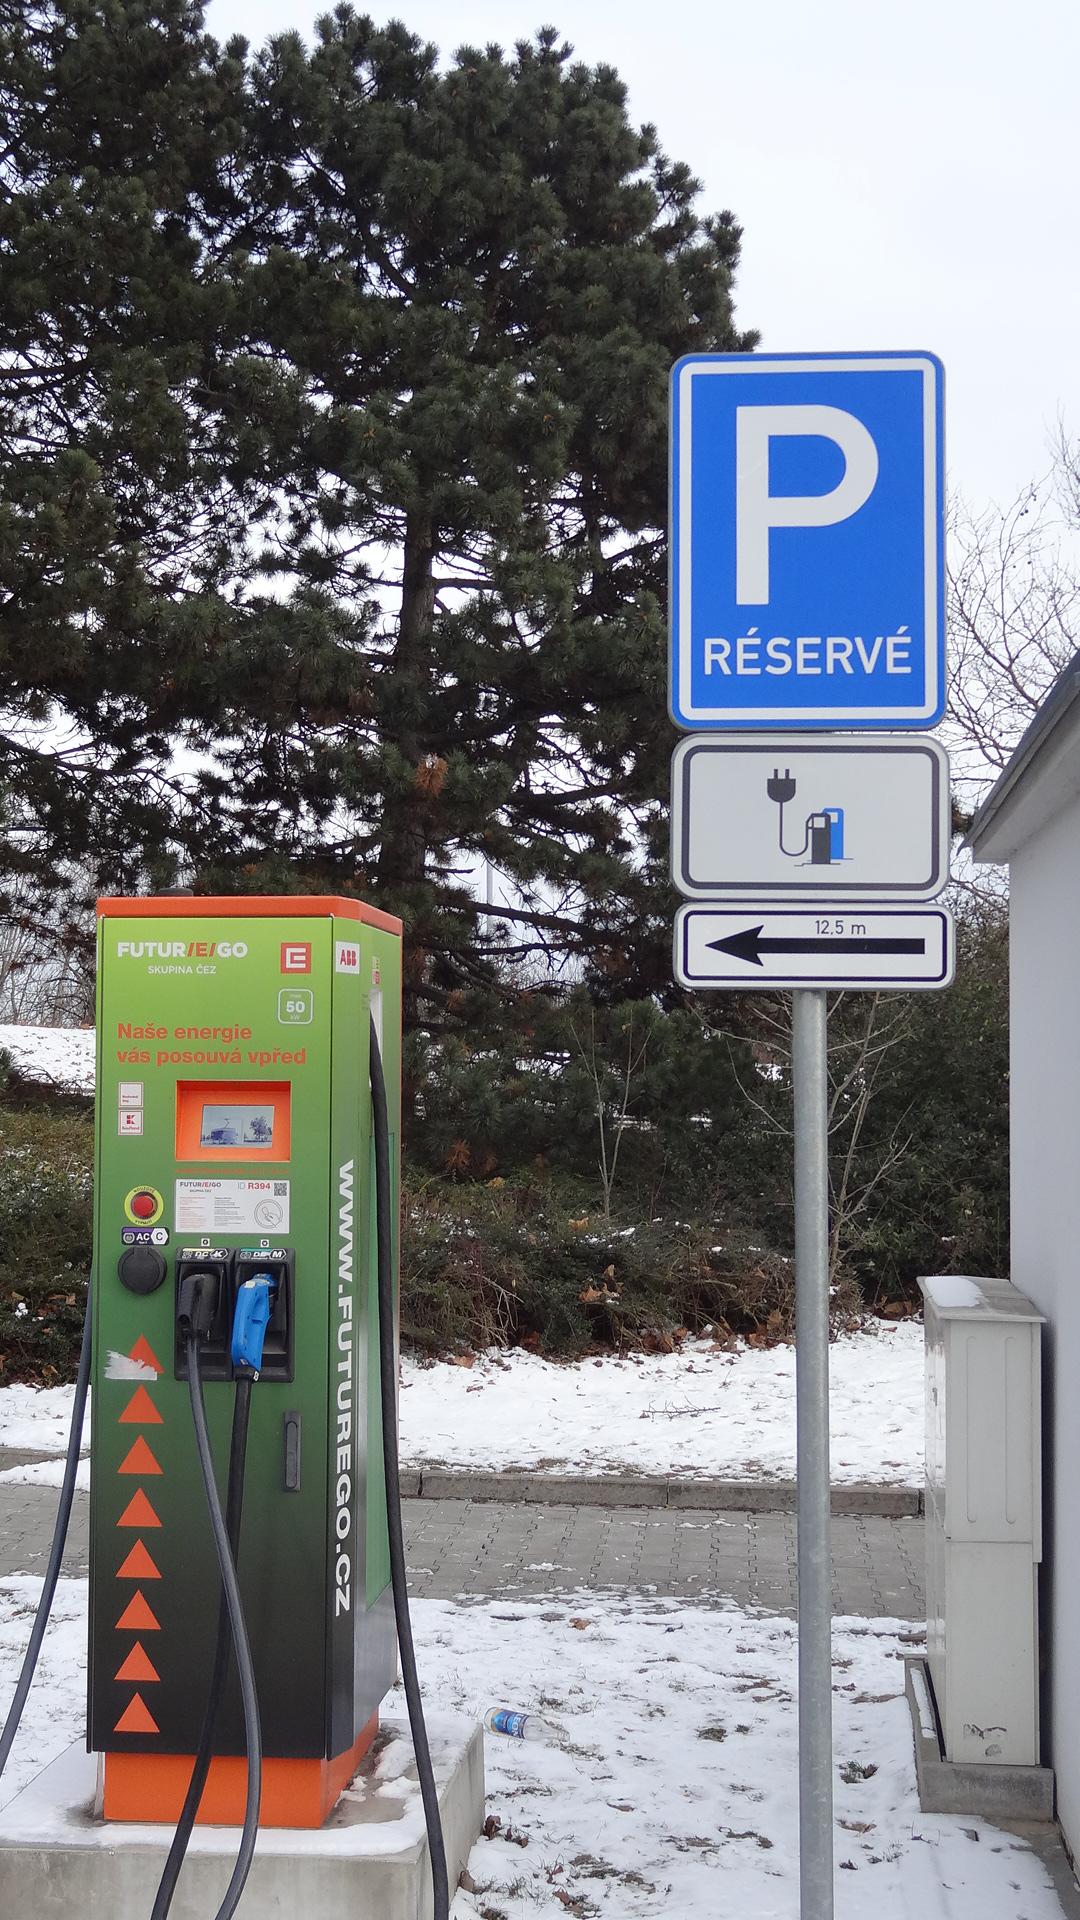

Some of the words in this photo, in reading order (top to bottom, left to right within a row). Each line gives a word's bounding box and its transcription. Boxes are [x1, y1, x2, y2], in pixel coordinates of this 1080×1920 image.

[736, 404, 879, 605] P
[704, 626, 912, 675] RÉSERVÉ
[815, 920, 844, 935] 12,5
[851, 924, 866, 935] m
[117, 942, 248, 958] FUTUR/E/GO
[340, 949, 357, 967] ABB
[148, 965, 193, 974] SKUPINA
[196, 963, 216, 974] ČEZ
[286, 1001, 306, 1013] 50
[117, 1022, 168, 1039] Naše
[174, 1023, 252, 1043] energie
[117, 1048, 150, 1064] vás
[157, 1048, 241, 1068] posouvá
[248, 1047, 306, 1068] vpřed
[247, 1182, 271, 1190] R394
[136, 1233, 150, 1241] AC
[156, 1232, 163, 1240] C
[271, 1250, 283, 1258] M
[336, 1159, 354, 1617] WWW.FUTUREGO.CZ
